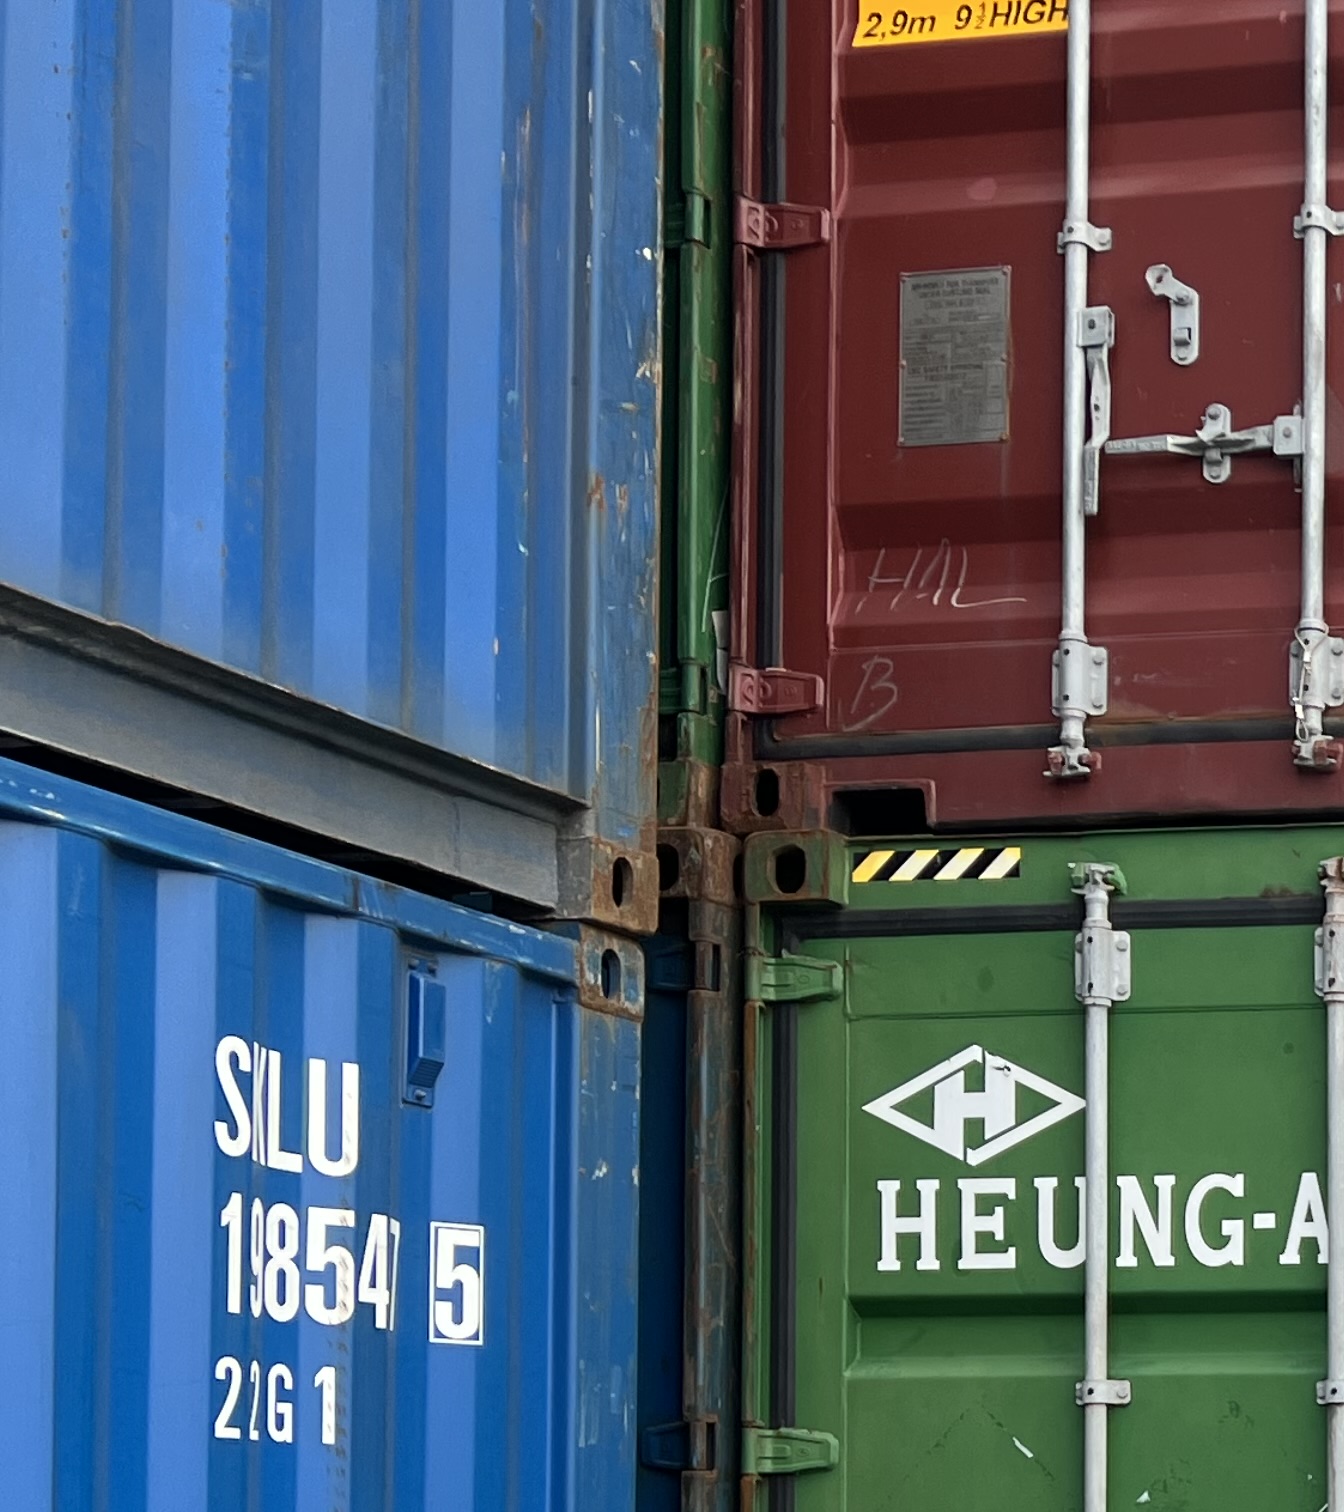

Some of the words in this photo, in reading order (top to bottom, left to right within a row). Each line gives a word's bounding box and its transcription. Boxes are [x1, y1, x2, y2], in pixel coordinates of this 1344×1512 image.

[214, 1035, 359, 1177] SKLU
[877, 1172, 1329, 1270] HEUNG-A
[432, 1225, 482, 1341] 5
